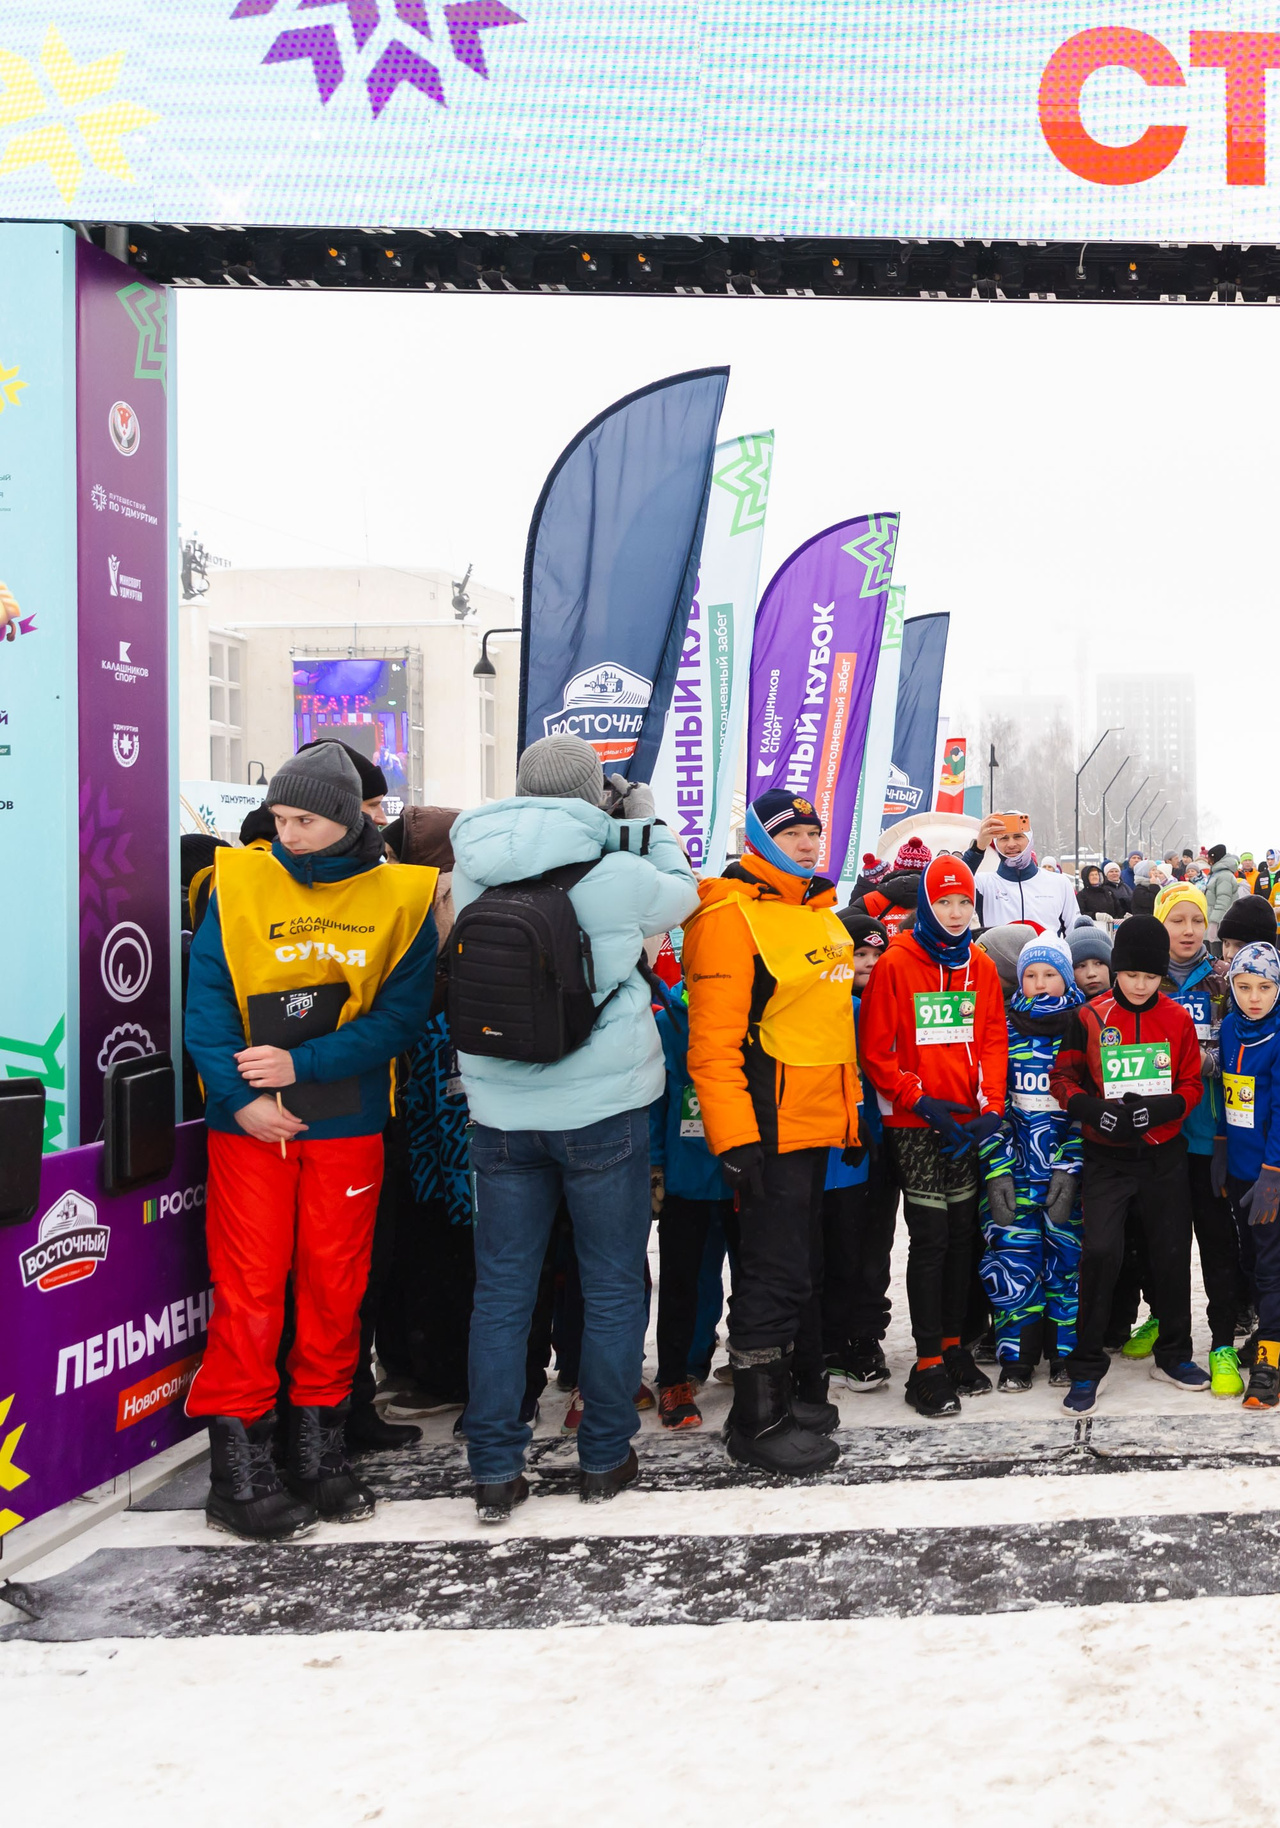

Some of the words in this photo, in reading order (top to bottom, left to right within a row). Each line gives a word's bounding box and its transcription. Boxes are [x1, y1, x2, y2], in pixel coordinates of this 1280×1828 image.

[109, 492, 146, 511] ПУТЕШЕСТВУЙ
[109, 501, 119, 512] ПО
[121, 505, 158, 525] УДМУРТИИ
[718, 611, 728, 652] забег
[803, 601, 835, 705] КУБОК
[102, 660, 149, 677] КАЛАШНИКОВ
[115, 671, 136, 684] СПОРТ
[296, 695, 370, 717] ТЕАТР
[760, 669, 780, 753] КАЛАШНИКОВ
[113, 723, 139, 733] УДМУРТИЯ
[770, 715, 783, 753] СПОРТ
[826, 697, 845, 790] многодневный
[839, 658, 851, 694] забег
[289, 924, 326, 935] СПОРТ
[290, 916, 375, 934] КАЛАШНИКОВ
[275, 940, 366, 967] СУДЬЯ
[290, 999, 310, 1013] ГТО
[919, 1004, 953, 1025] 912
[1106, 1057, 1145, 1079] 917
[1015, 1071, 1050, 1092] 100
[26, 1232, 106, 1277] ВОСТОЧНЫЙ
